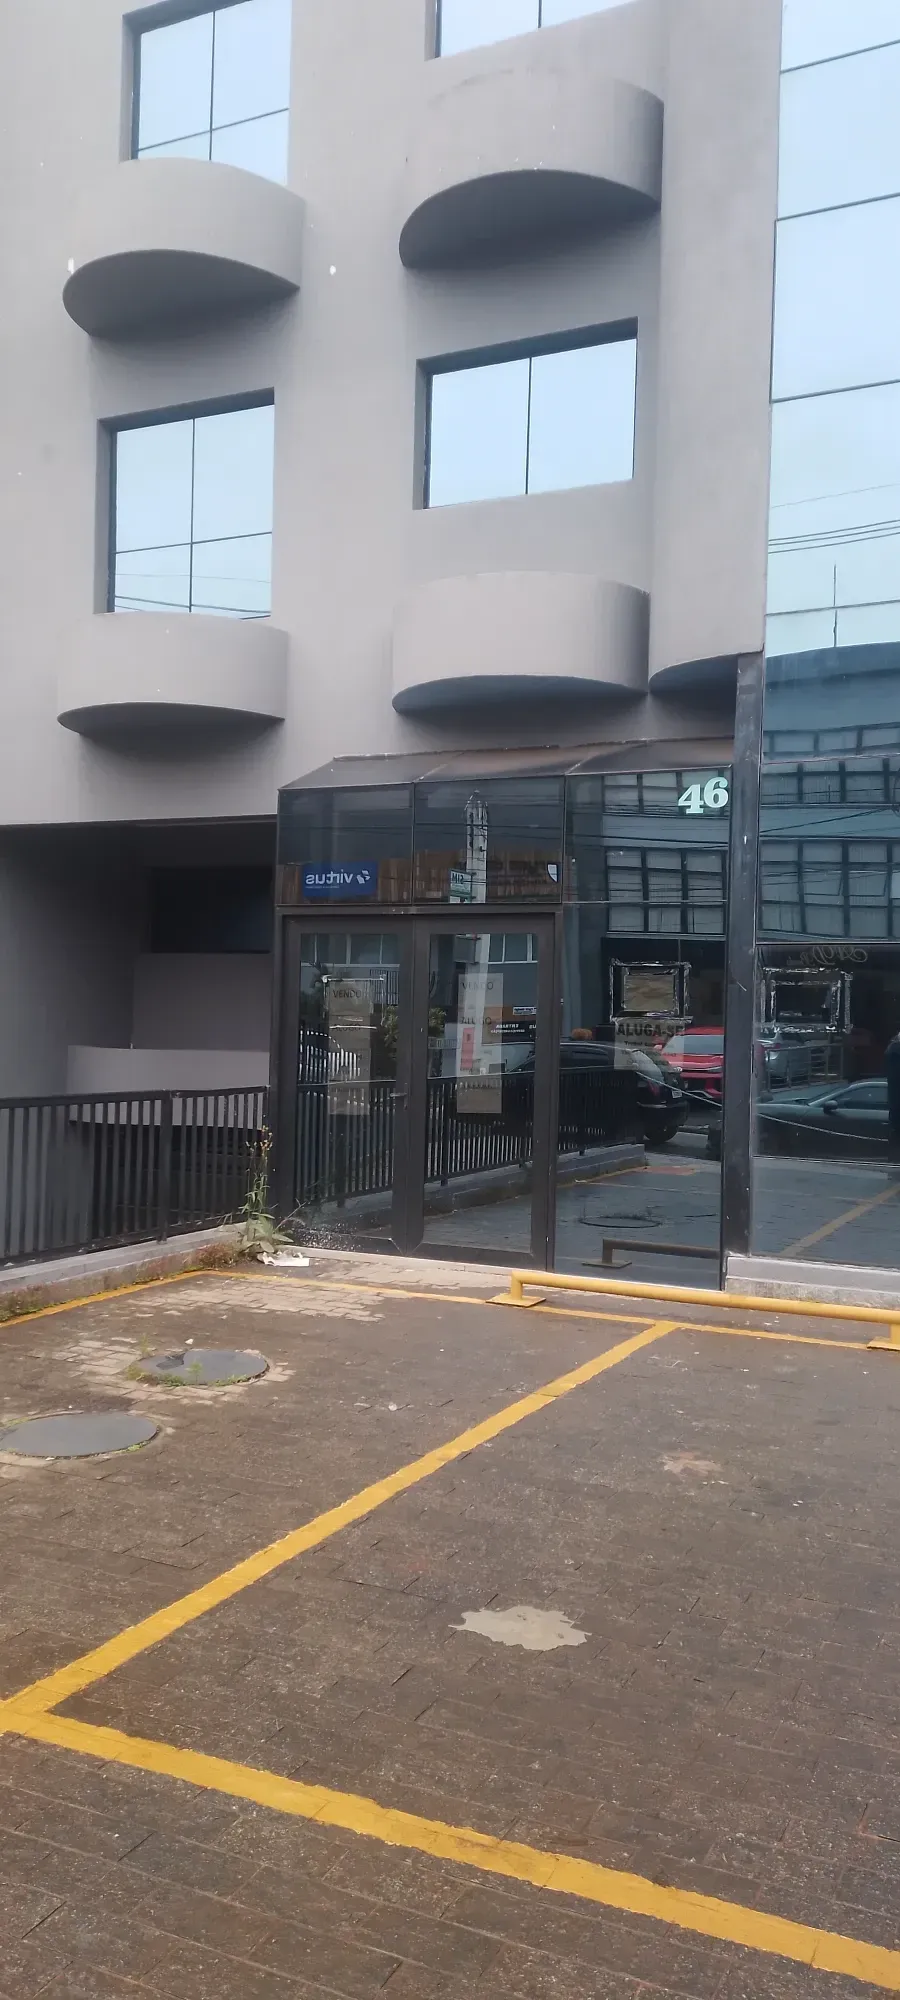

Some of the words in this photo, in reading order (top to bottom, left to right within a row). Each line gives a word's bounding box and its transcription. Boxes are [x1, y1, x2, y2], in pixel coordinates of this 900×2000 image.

[677, 776, 730, 814] 46
[461, 981, 494, 991] VENDO
[332, 989, 362, 999] VENDO
[616, 1022, 684, 1037] ALUGA-SE
